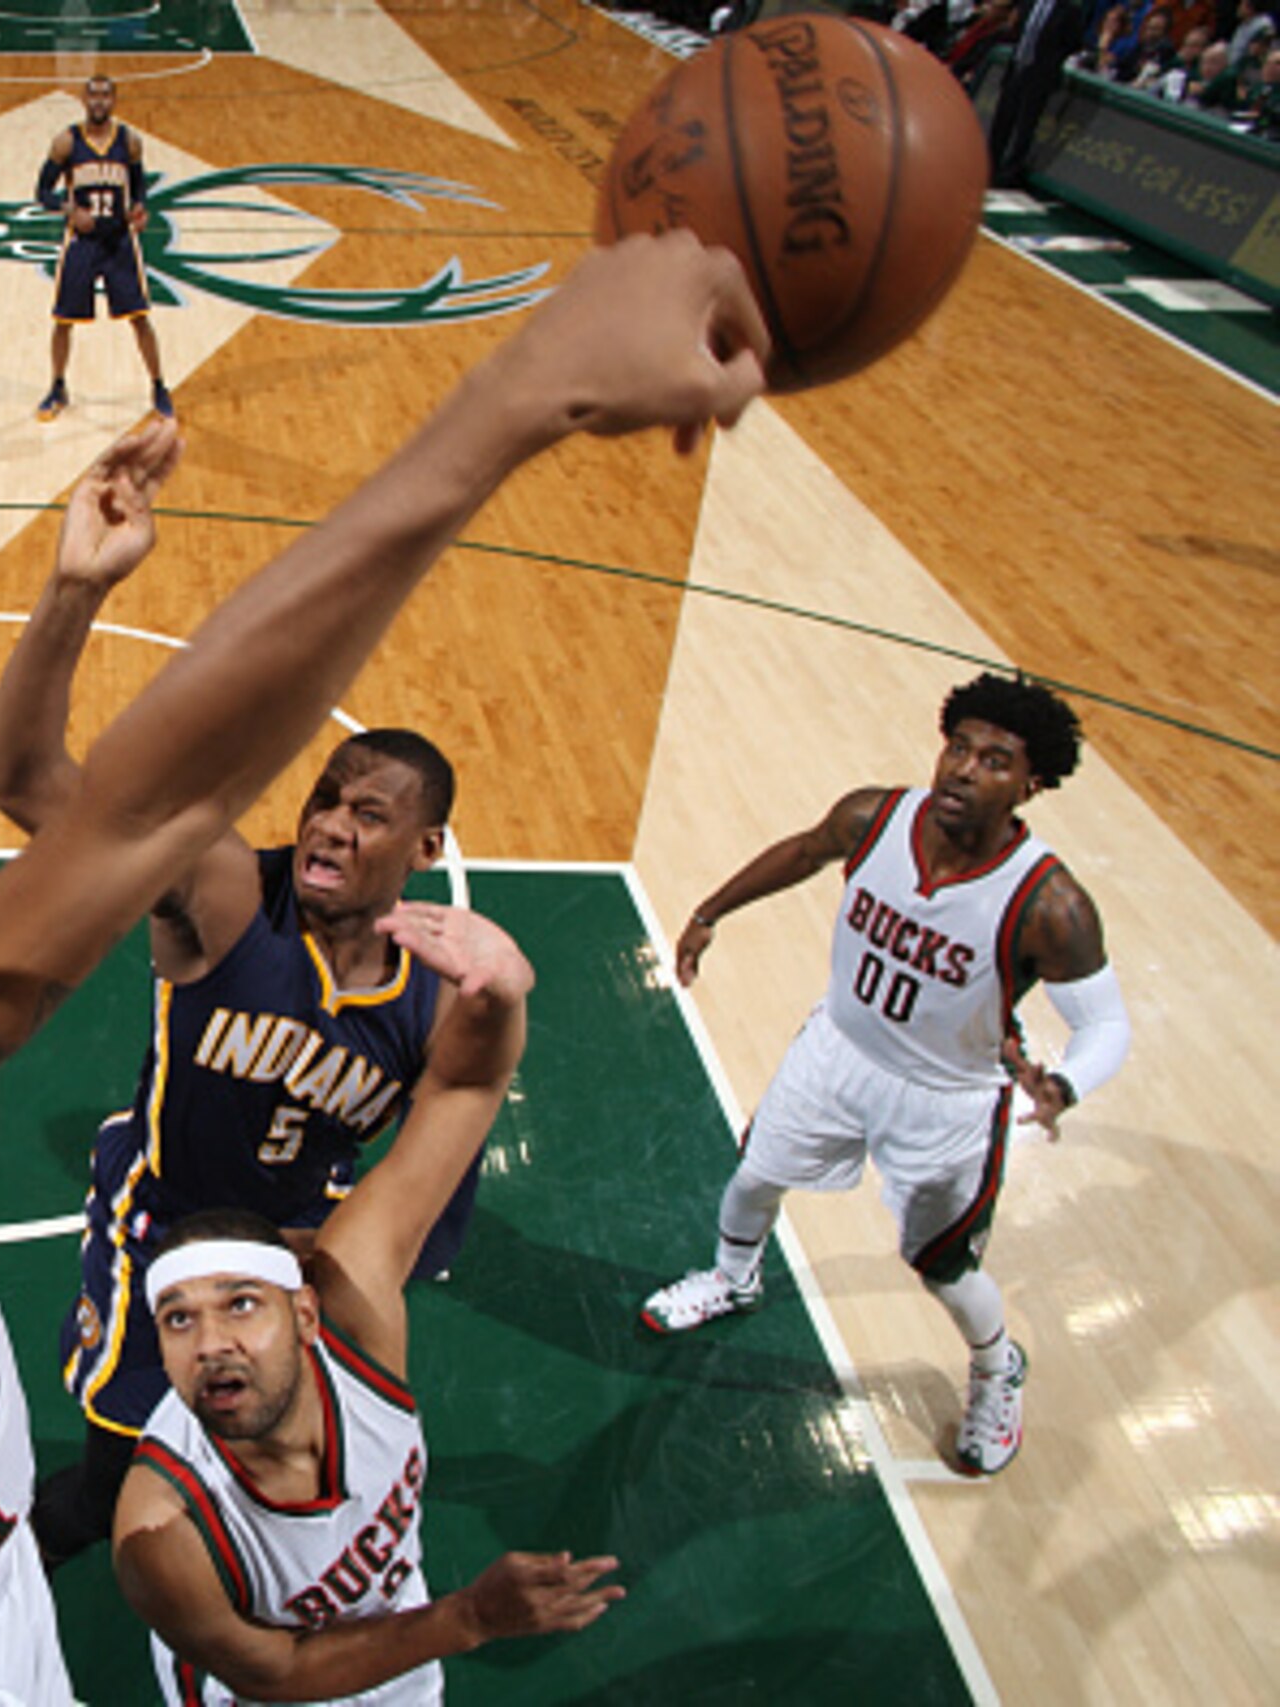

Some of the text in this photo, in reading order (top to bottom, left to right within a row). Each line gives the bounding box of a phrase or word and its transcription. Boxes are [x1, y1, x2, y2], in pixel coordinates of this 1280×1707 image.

[749, 20, 849, 260] SPALDING
[1133, 154, 1182, 193] FOR
[845, 886, 977, 989] BUCKS
[852, 950, 923, 1025] 00
[193, 1007, 402, 1135] INDIANA
[258, 1104, 310, 1165] 5
[282, 1446, 426, 1631] BUCKS
